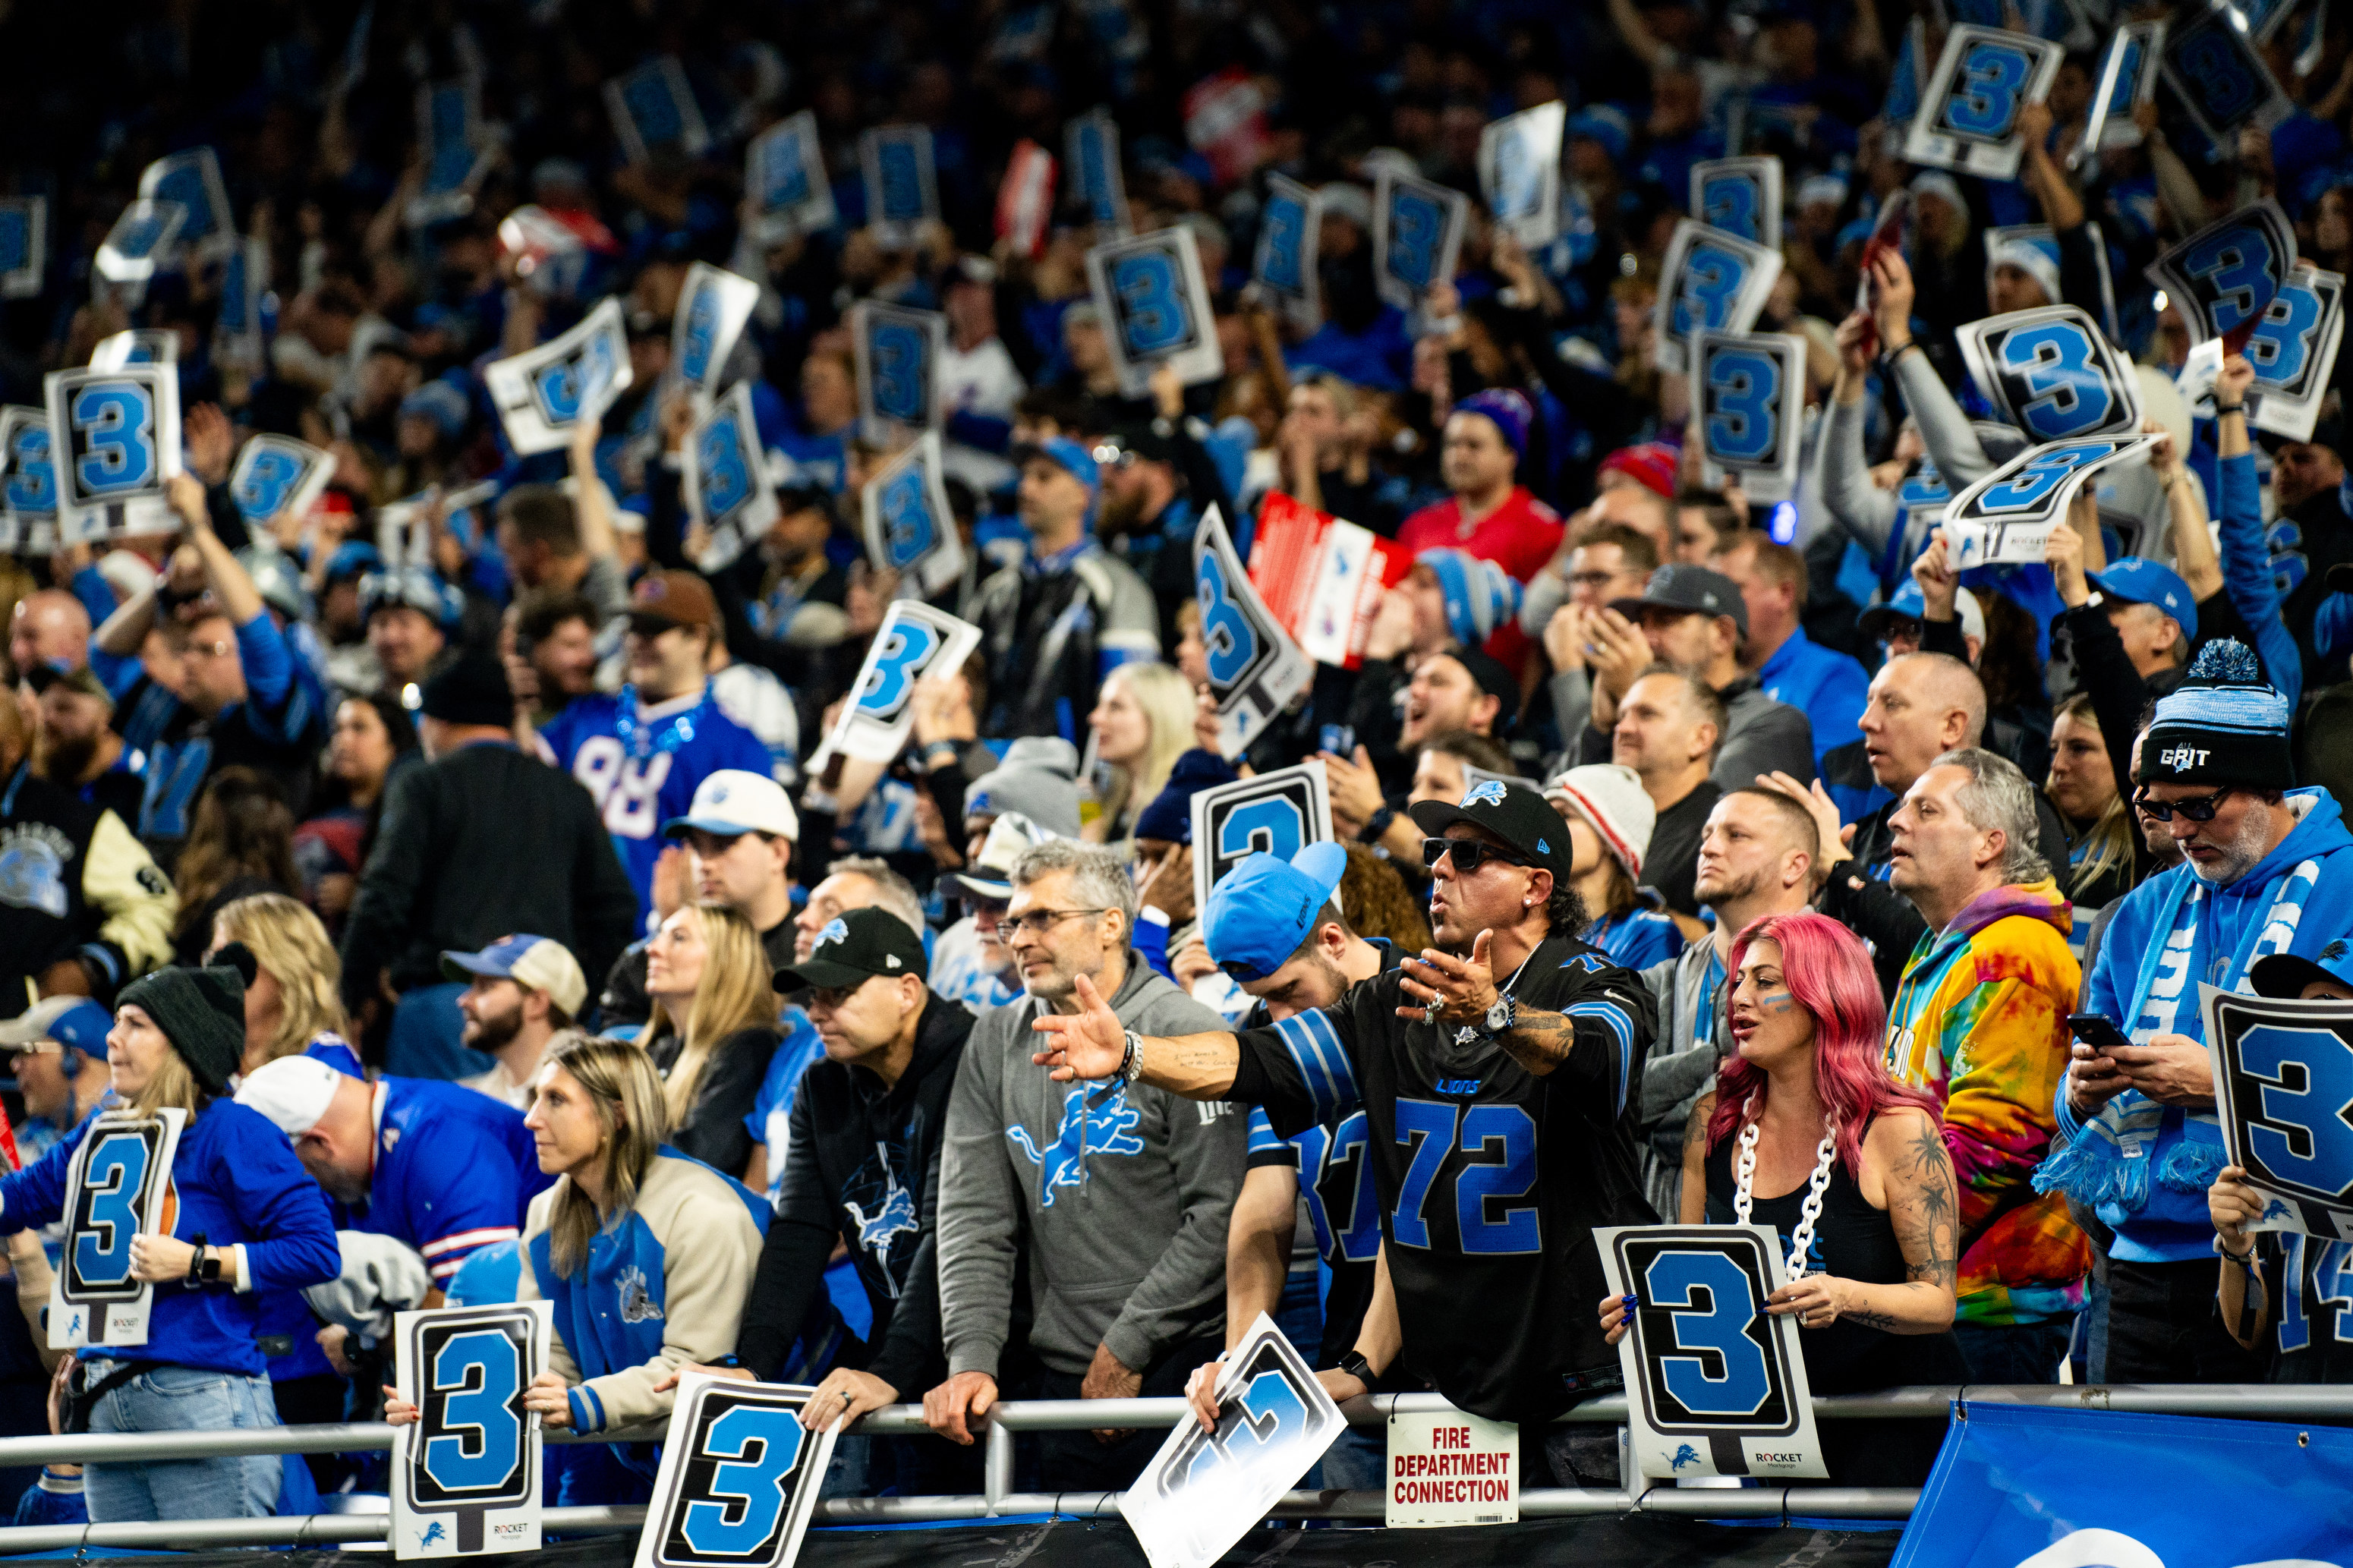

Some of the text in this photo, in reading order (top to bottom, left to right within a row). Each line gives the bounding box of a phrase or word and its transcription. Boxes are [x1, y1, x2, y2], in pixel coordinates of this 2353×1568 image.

[1945, 42, 2032, 137] 3
[1111, 251, 1191, 351] 3
[2183, 227, 2278, 335] 3
[1709, 348, 1780, 459] 3
[1999, 319, 2115, 440] 3
[73, 381, 154, 493] 3
[1977, 442, 2115, 514] 3
[1197, 546, 1259, 685] 3
[2160, 749, 2211, 766] GRIT
[1435, 1078, 1482, 1094] LIONS
[2238, 1023, 2353, 1197] 3
[74, 1132, 150, 1287] 3
[1391, 1096, 1542, 1255] 72
[1645, 1251, 1772, 1415] 3
[424, 1328, 521, 1492] 3
[1433, 1427, 1470, 1449] FIRE
[1756, 1453, 1802, 1463] ROCKET
[680, 1404, 806, 1555] 3
[1394, 1453, 1510, 1477] DEPARTMENT
[1394, 1479, 1509, 1504] CONNECTION
[494, 1522, 528, 1535] ROCKET
